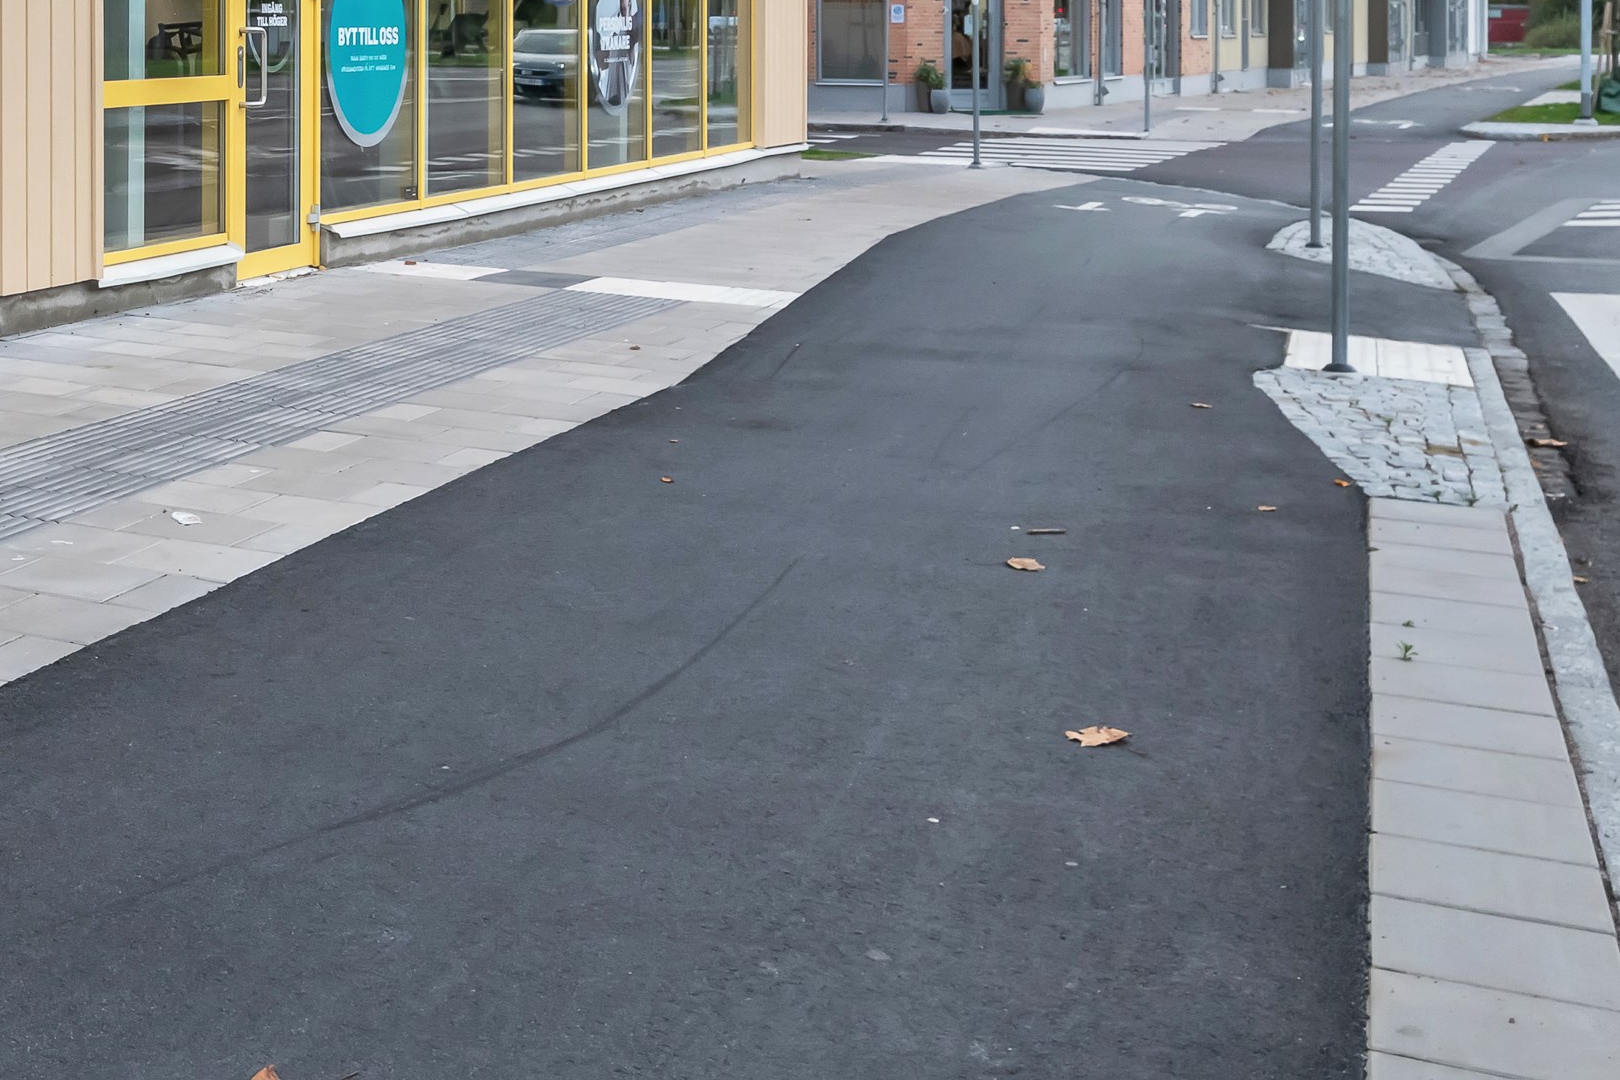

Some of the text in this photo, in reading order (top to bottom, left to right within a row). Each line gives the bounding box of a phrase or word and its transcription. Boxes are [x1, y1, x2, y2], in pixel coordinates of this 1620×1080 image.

[261, 1, 283, 14] INGÅNG
[256, 16, 269, 27] TILL
[338, 26, 399, 46] BYT TILL OSS
